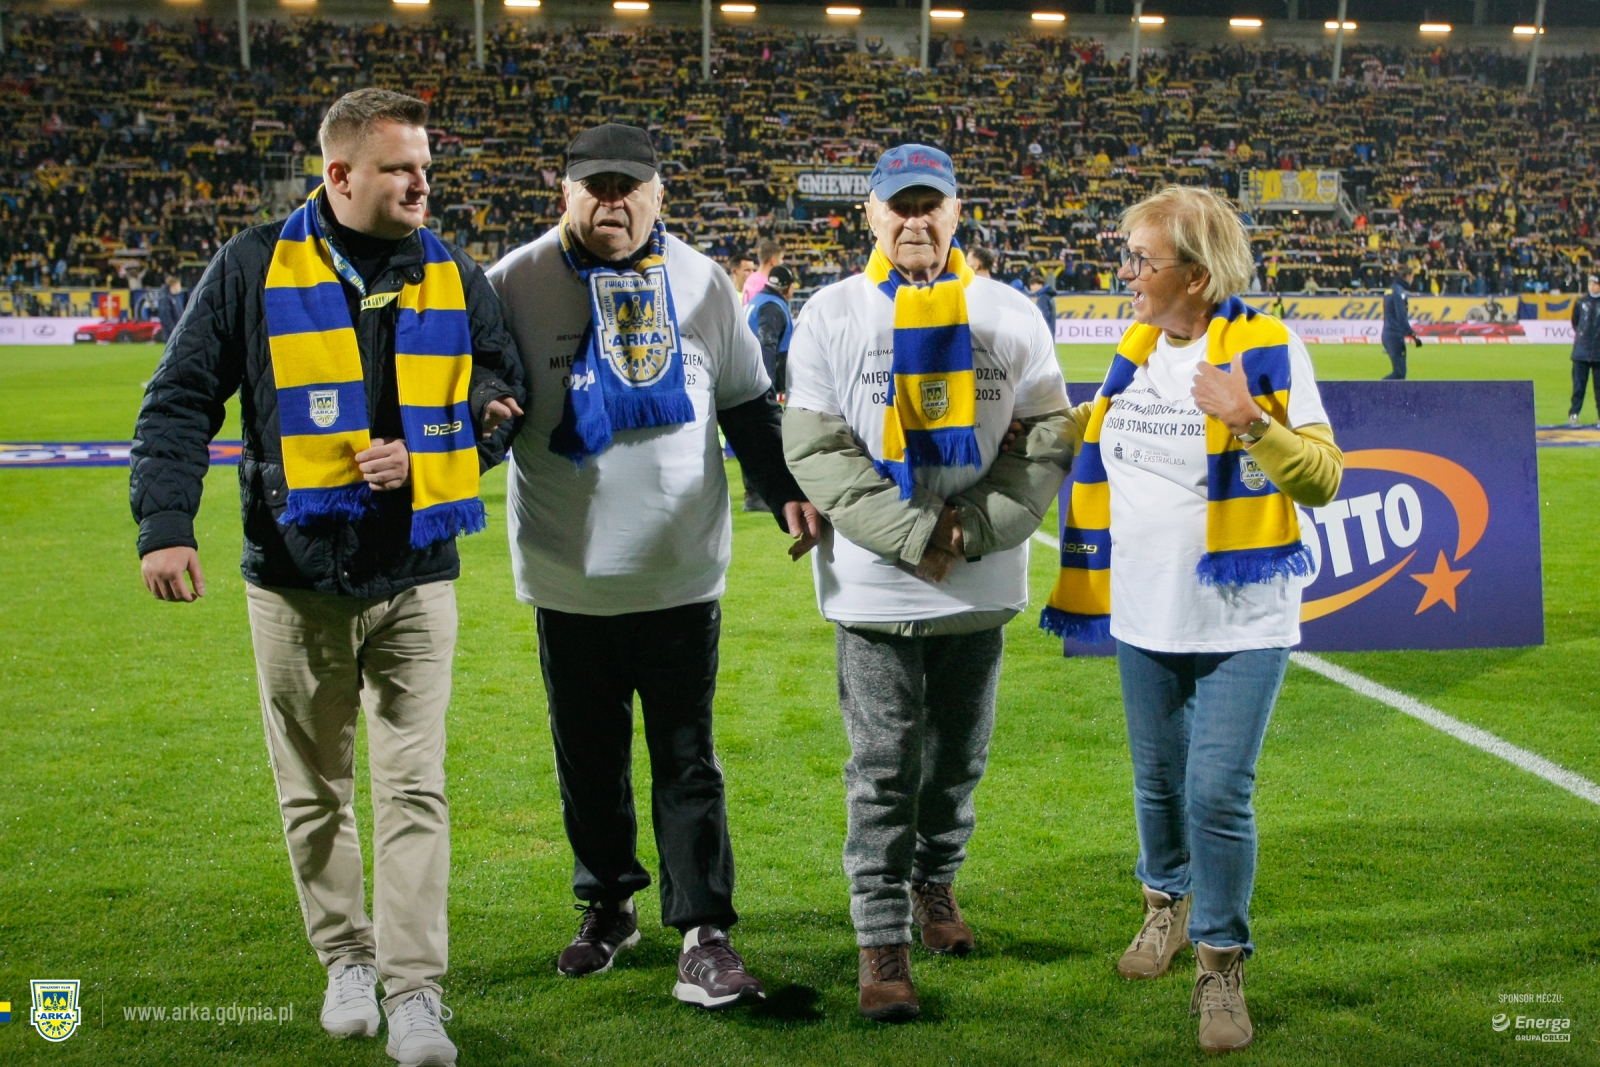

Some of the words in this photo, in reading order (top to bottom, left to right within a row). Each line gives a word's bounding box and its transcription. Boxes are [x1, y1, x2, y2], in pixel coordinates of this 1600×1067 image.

[798, 173, 871, 194] GNIEWIN
[1069, 326, 1113, 337] DILER
[1304, 327, 1346, 336] WALDER
[613, 332, 662, 347] ARKA
[682, 353, 703, 366] ZIEŃ
[975, 389, 1001, 401] 2025
[423, 420, 463, 436] 1929
[1106, 416, 1125, 430] OSÓB
[1126, 419, 1178, 436] STARSZYCH
[1144, 454, 1186, 465] EKSTRAKLASA
[1299, 483, 1423, 589] OTTO
[1062, 543, 1098, 554] 1929
